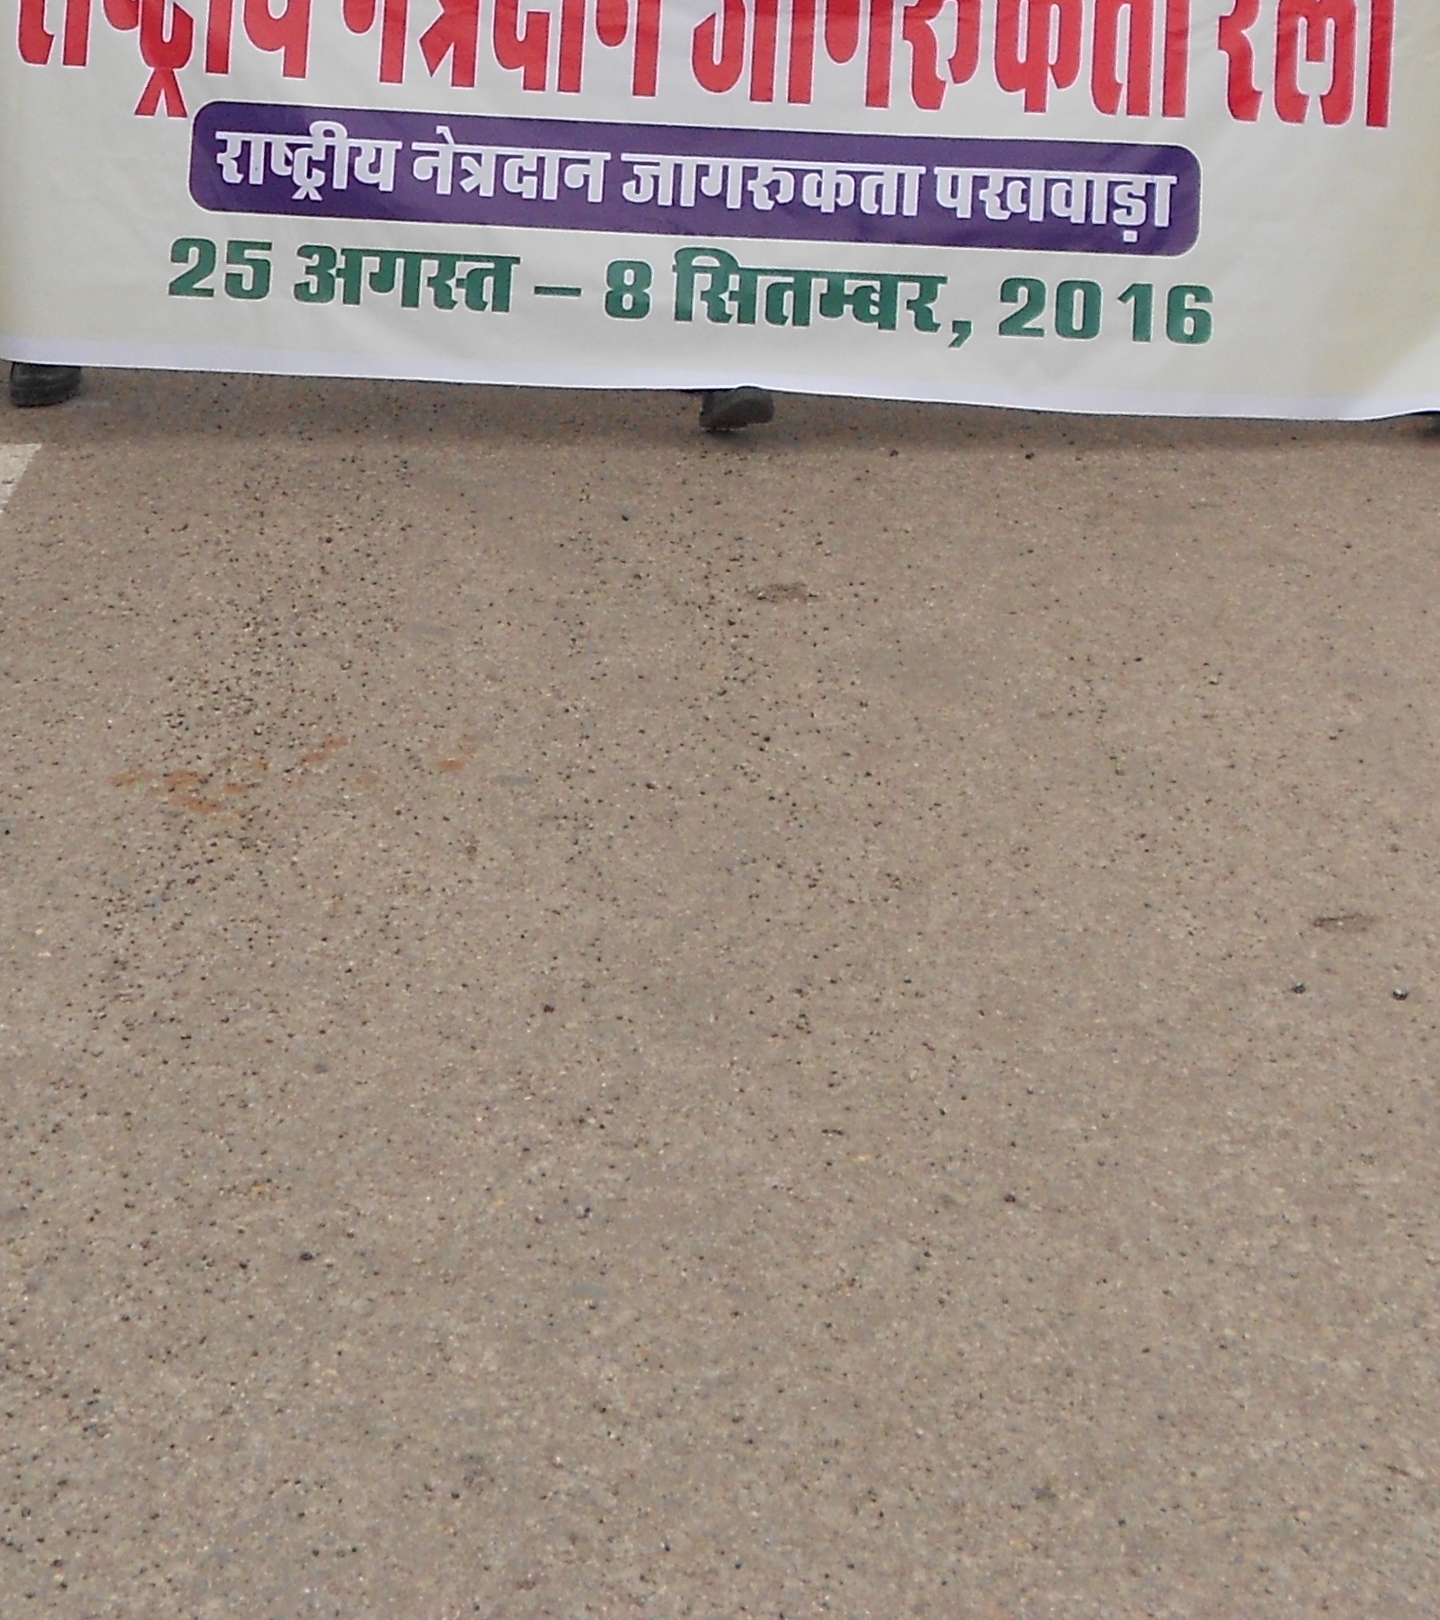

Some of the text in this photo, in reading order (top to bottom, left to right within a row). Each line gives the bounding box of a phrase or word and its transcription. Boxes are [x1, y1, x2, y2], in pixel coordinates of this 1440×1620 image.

[216, 121, 402, 201] राष्ट्रीय
[411, 126, 610, 204] नेत्रदान
[935, 164, 1177, 243] पखवाड़ा
[167, 237, 272, 301] 25
[294, 242, 520, 313] अगस्त
[604, 258, 653, 320] 8
[672, 246, 974, 348] सितम्बर,
[998, 277, 1214, 346] 2016
